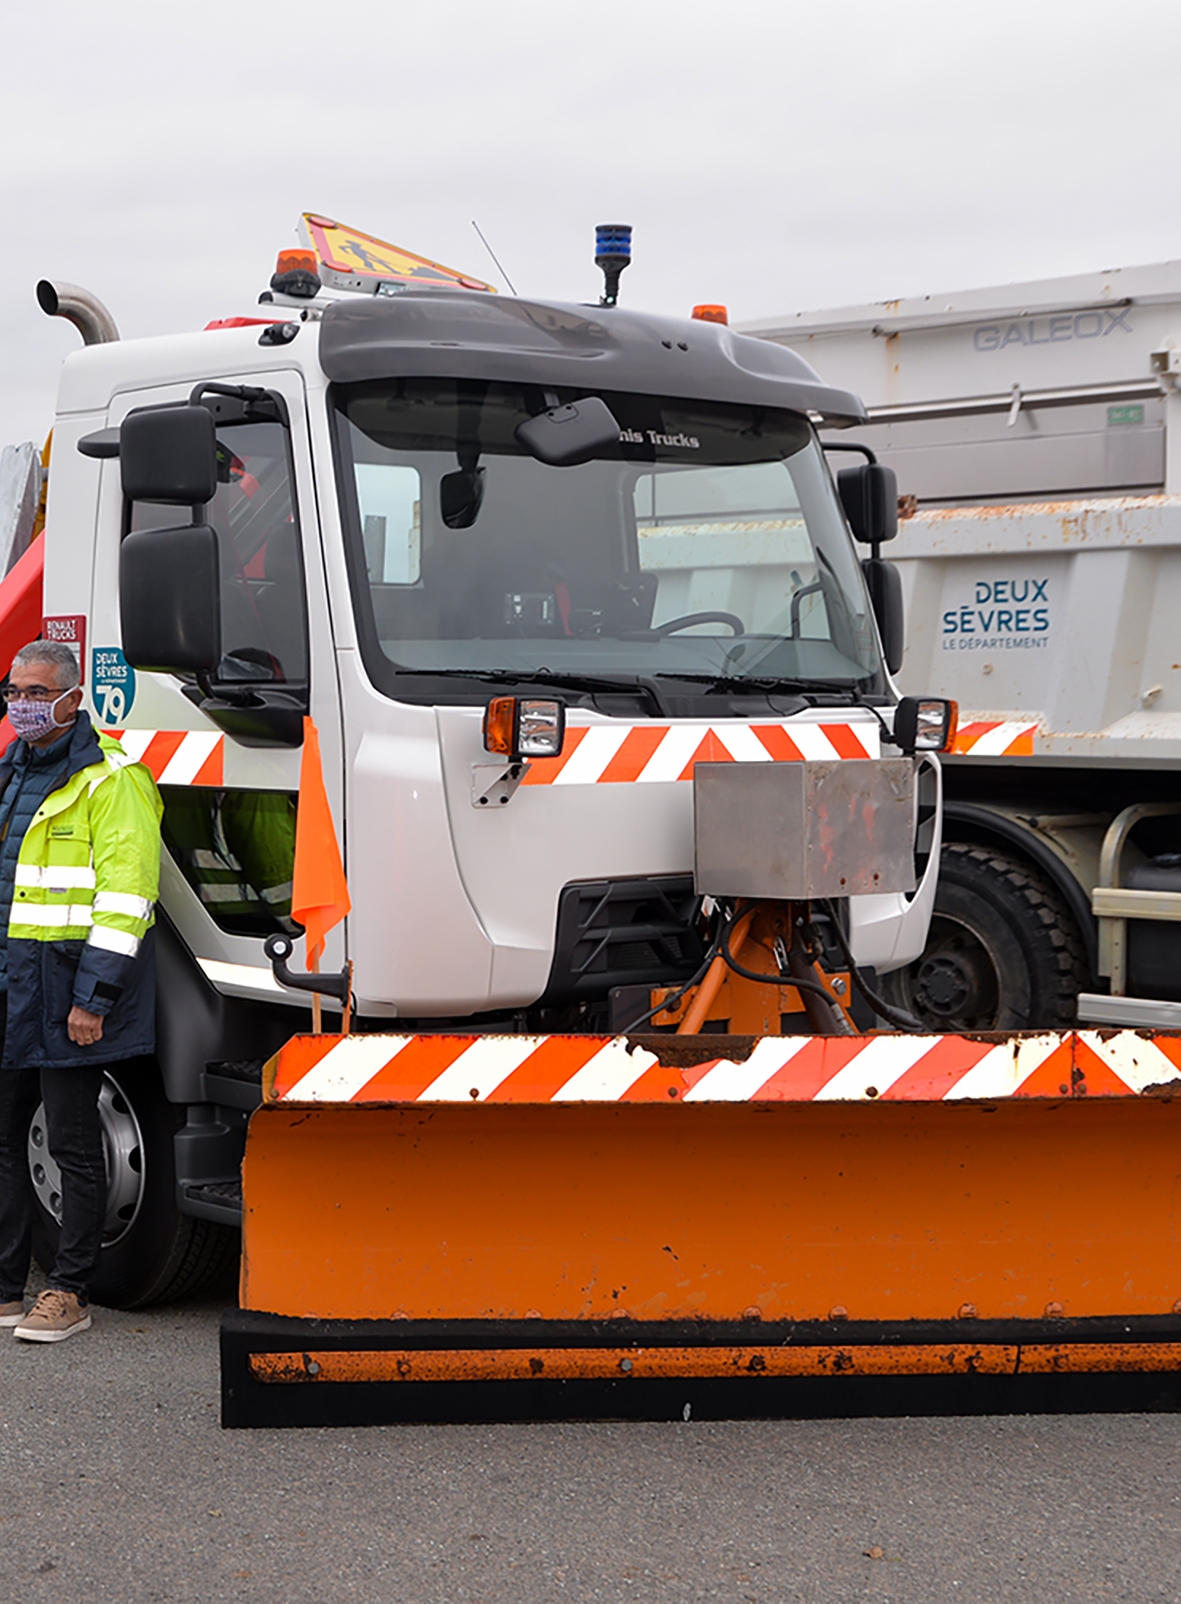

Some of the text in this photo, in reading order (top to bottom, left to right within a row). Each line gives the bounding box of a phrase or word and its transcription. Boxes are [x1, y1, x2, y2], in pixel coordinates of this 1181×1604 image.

[973, 307, 1134, 352] GALEOX
[619, 427, 700, 449] nis Trucks
[975, 579, 1049, 604] DEUX
[47, 629, 77, 640] TRUCKS
[943, 637, 1049, 650] LE DÉPARTEMENT
[96, 652, 119, 665] DEUX
[96, 685, 126, 726] 79
